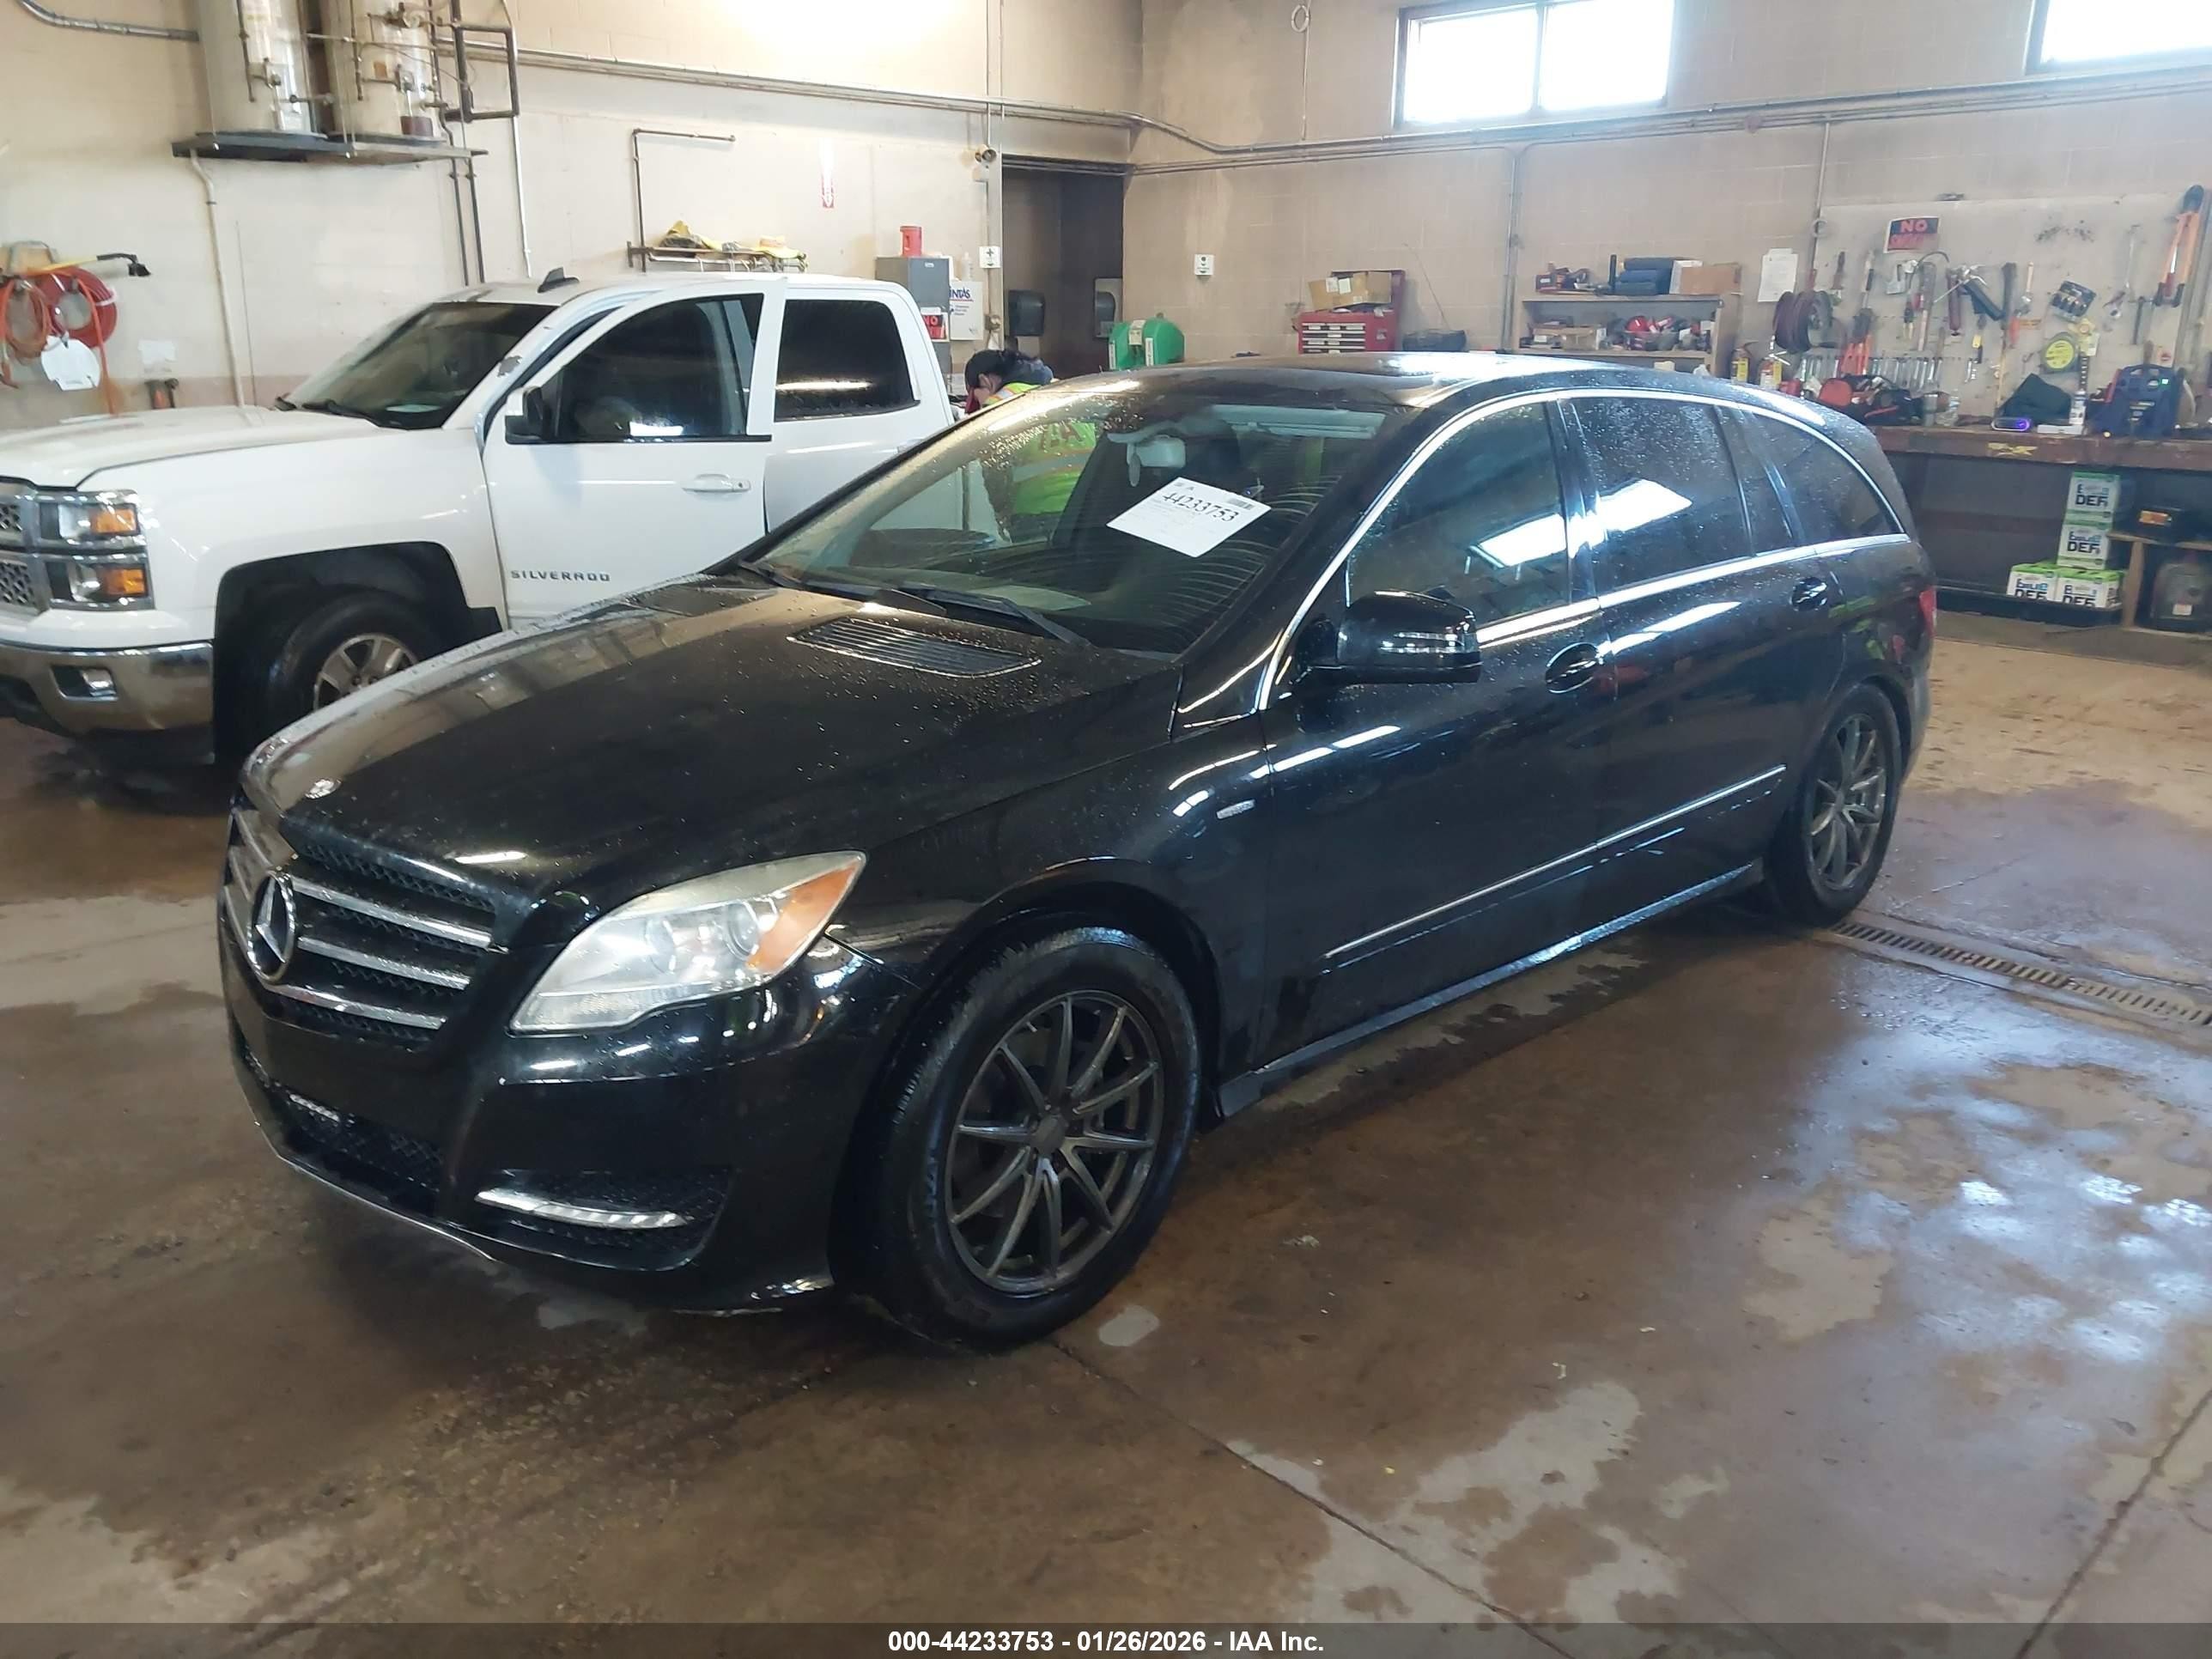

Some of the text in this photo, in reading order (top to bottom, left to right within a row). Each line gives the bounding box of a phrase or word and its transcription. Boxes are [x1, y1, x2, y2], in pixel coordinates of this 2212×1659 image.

[1900, 219, 1928, 233] NO
[1163, 492, 1239, 522] 44233753
[2075, 495, 2108, 507] DEF
[2067, 541, 2100, 554] DEF
[510, 570, 611, 581] SILVERADO
